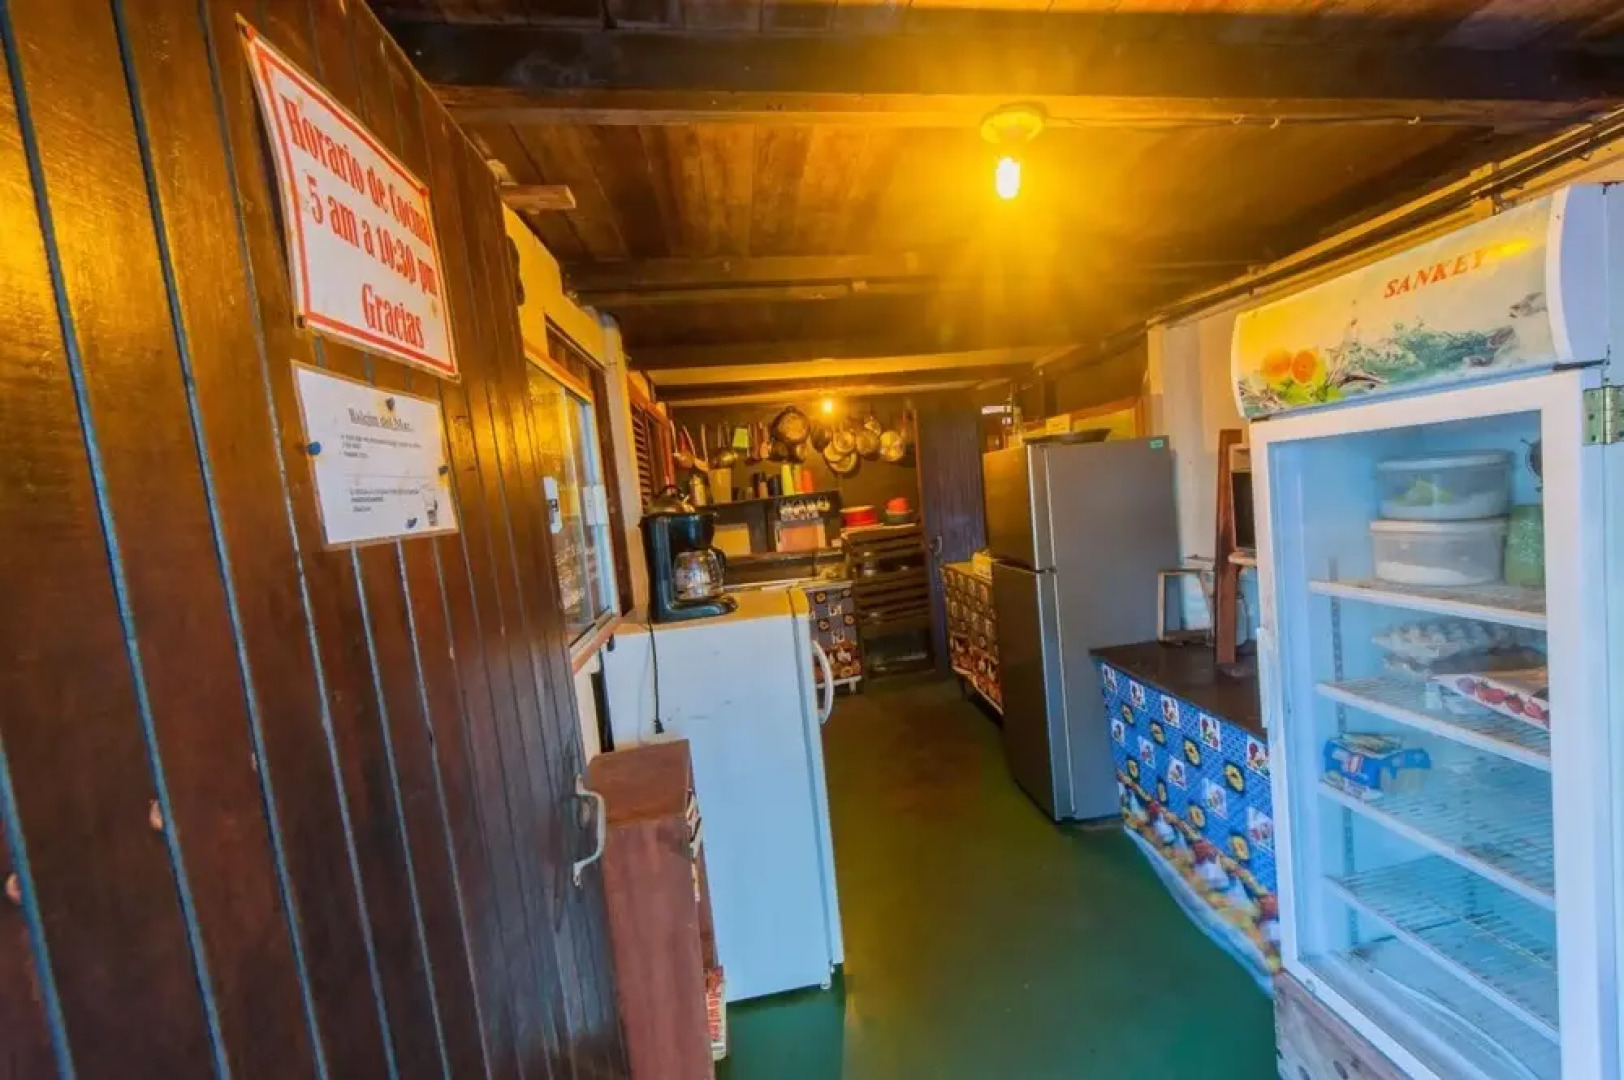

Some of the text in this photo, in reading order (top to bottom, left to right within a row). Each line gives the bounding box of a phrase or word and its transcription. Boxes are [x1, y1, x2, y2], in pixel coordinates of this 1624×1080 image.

[282, 95, 365, 195] Horario
[367, 166, 388, 213] de
[305, 172, 438, 297] 5 am a 10:30 pm
[1384, 249, 1488, 300] SANKEY
[362, 283, 425, 350] Gracias
